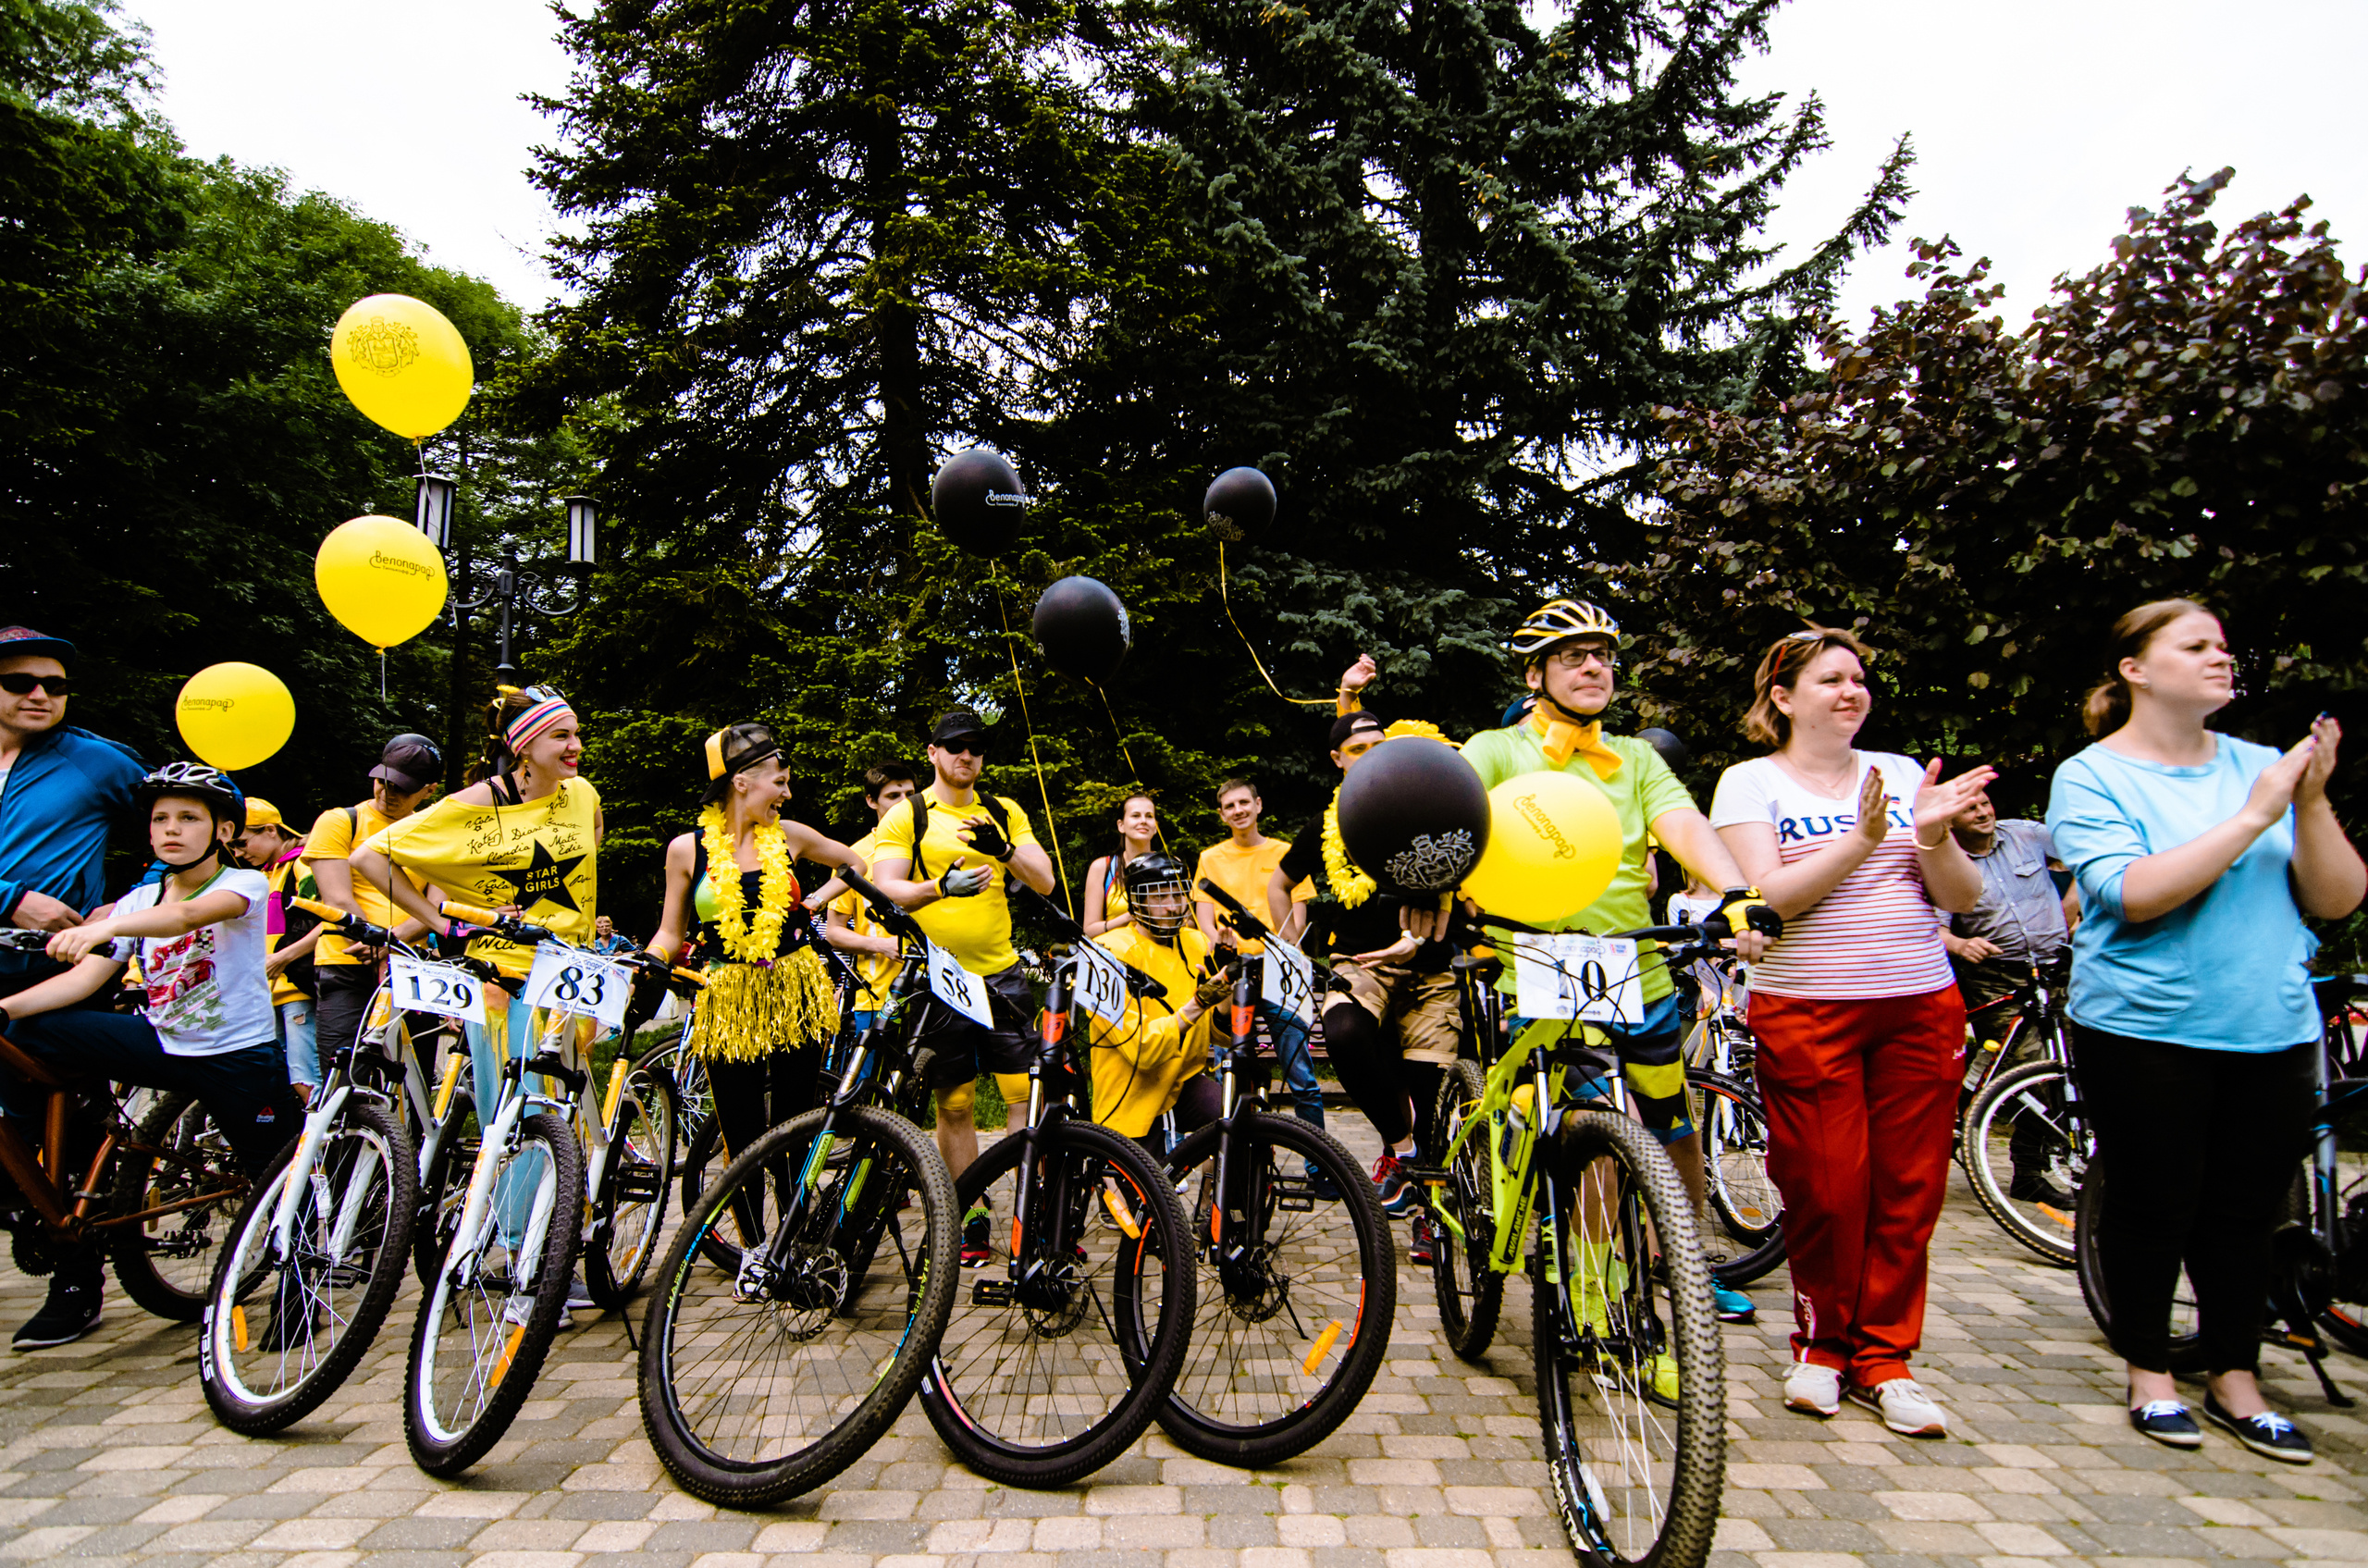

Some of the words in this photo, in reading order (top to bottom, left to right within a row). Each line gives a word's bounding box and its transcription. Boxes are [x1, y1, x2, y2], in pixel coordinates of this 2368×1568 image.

[369, 549, 435, 581] Велопарад
[524, 877, 560, 893] GIRLS
[525, 865, 558, 881] STAR
[405, 975, 473, 1009] 129
[555, 967, 605, 1006] 83
[942, 968, 972, 1007] 58
[1082, 961, 1120, 1011] 130
[1280, 960, 1308, 1002] 82
[1551, 959, 1607, 1002] 10
[1507, 1194, 1529, 1258] AVALANCHE
[201, 1304, 216, 1381] STELS
